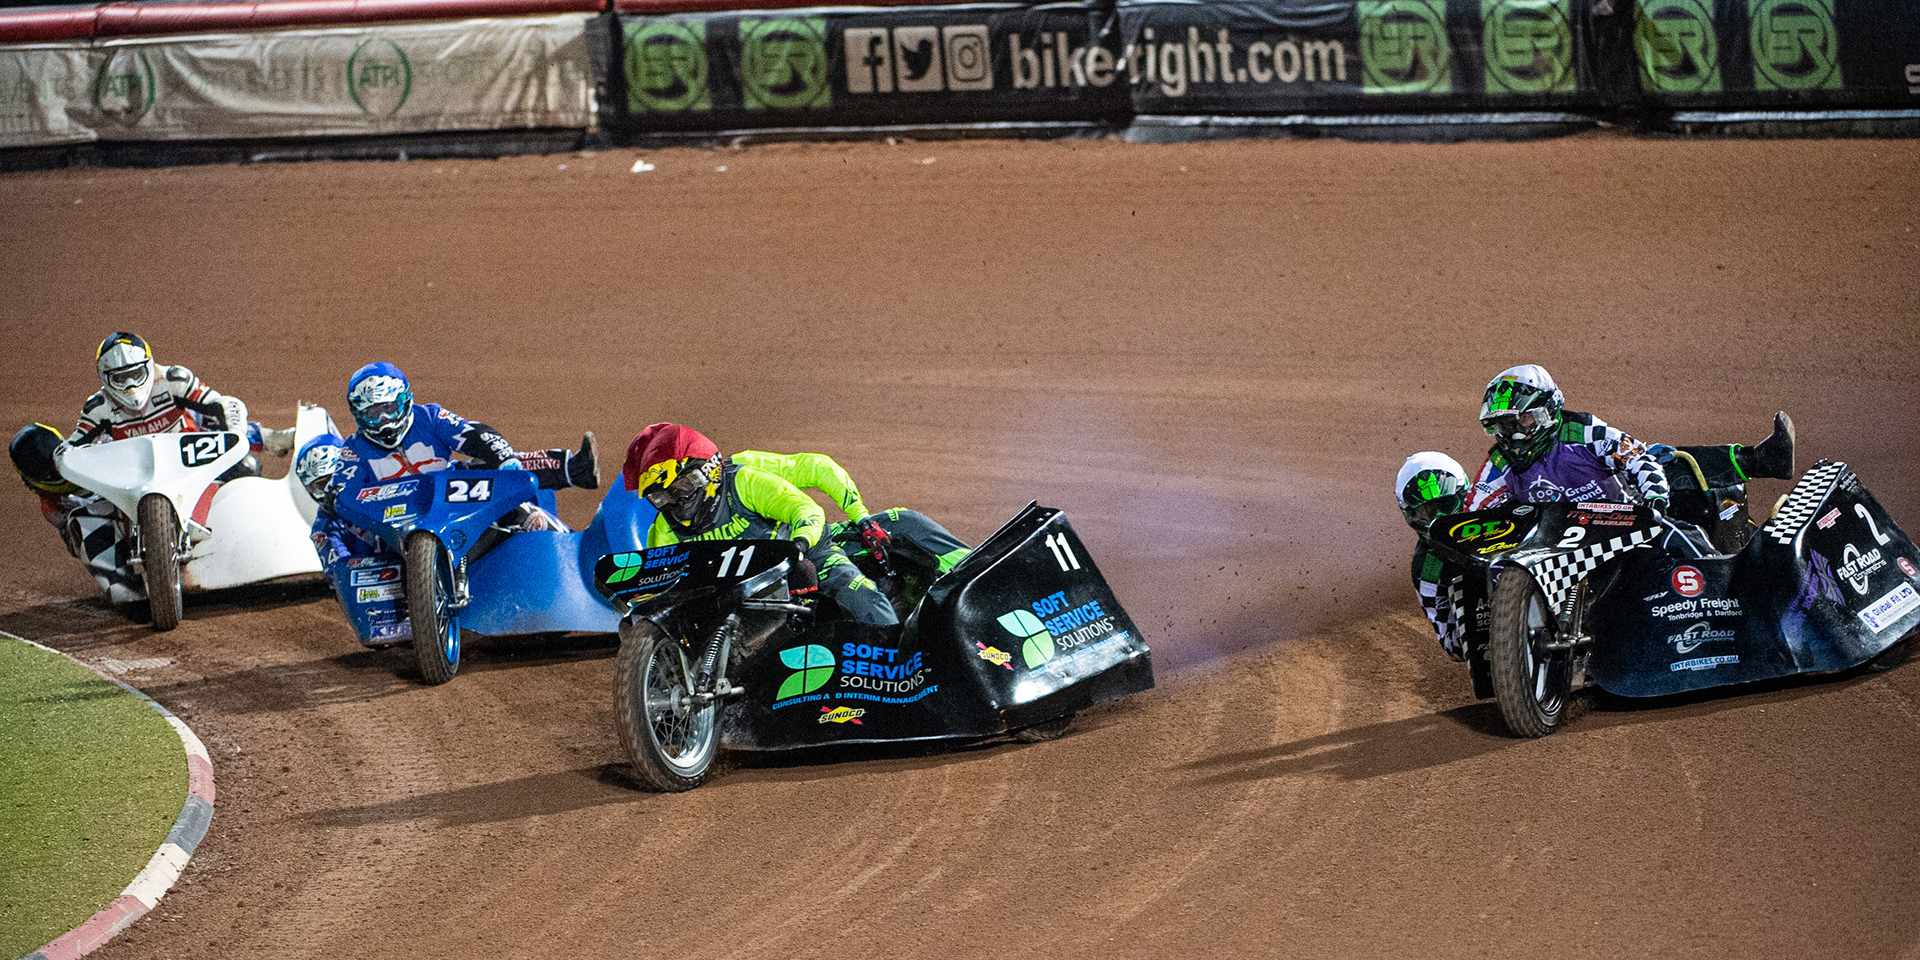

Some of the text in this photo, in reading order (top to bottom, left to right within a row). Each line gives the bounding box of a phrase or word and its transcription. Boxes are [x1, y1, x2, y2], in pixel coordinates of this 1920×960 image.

[124, 417, 170, 438] YAMAHA
[182, 433, 226, 465] 121
[448, 480, 491, 502] 24
[1565, 479, 1599, 498] Great
[1571, 485, 1604, 502] mond
[1577, 502, 1634, 511] INTABIKES.CO.UK
[703, 513, 751, 540] RACING
[1461, 521, 1501, 537] DT
[1854, 503, 1891, 546] 2
[1556, 526, 1586, 548] 2
[643, 550, 691, 569] SERVICE
[646, 545, 677, 559] SOFT
[717, 545, 755, 578] 11
[1045, 532, 1081, 572] 11
[1837, 548, 1881, 580] FAST ROAD
[1032, 590, 1070, 619] SOFT
[1890, 594, 1902, 605] Fit
[1898, 587, 1913, 598] LTD
[1651, 598, 1740, 617] Speedy Freight
[1667, 611, 1704, 621] Tonbridge
[1044, 600, 1105, 637] SERVICE
[1056, 618, 1114, 651] SOLUTIONS
[1667, 630, 1735, 644] FAST ROAD
[841, 642, 899, 663] SOFT
[981, 649, 1011, 662] SUNOCO
[1671, 655, 1739, 671] INTABIKES.CO.UK
[841, 651, 923, 680] SERVICE
[840, 670, 925, 693] SOLUTIONS
[772, 694, 822, 710] CONSULTING
[843, 692, 881, 702] INTERIM
[882, 684, 939, 704] MANAGEMENT
[820, 708, 864, 723] SUNOCO
